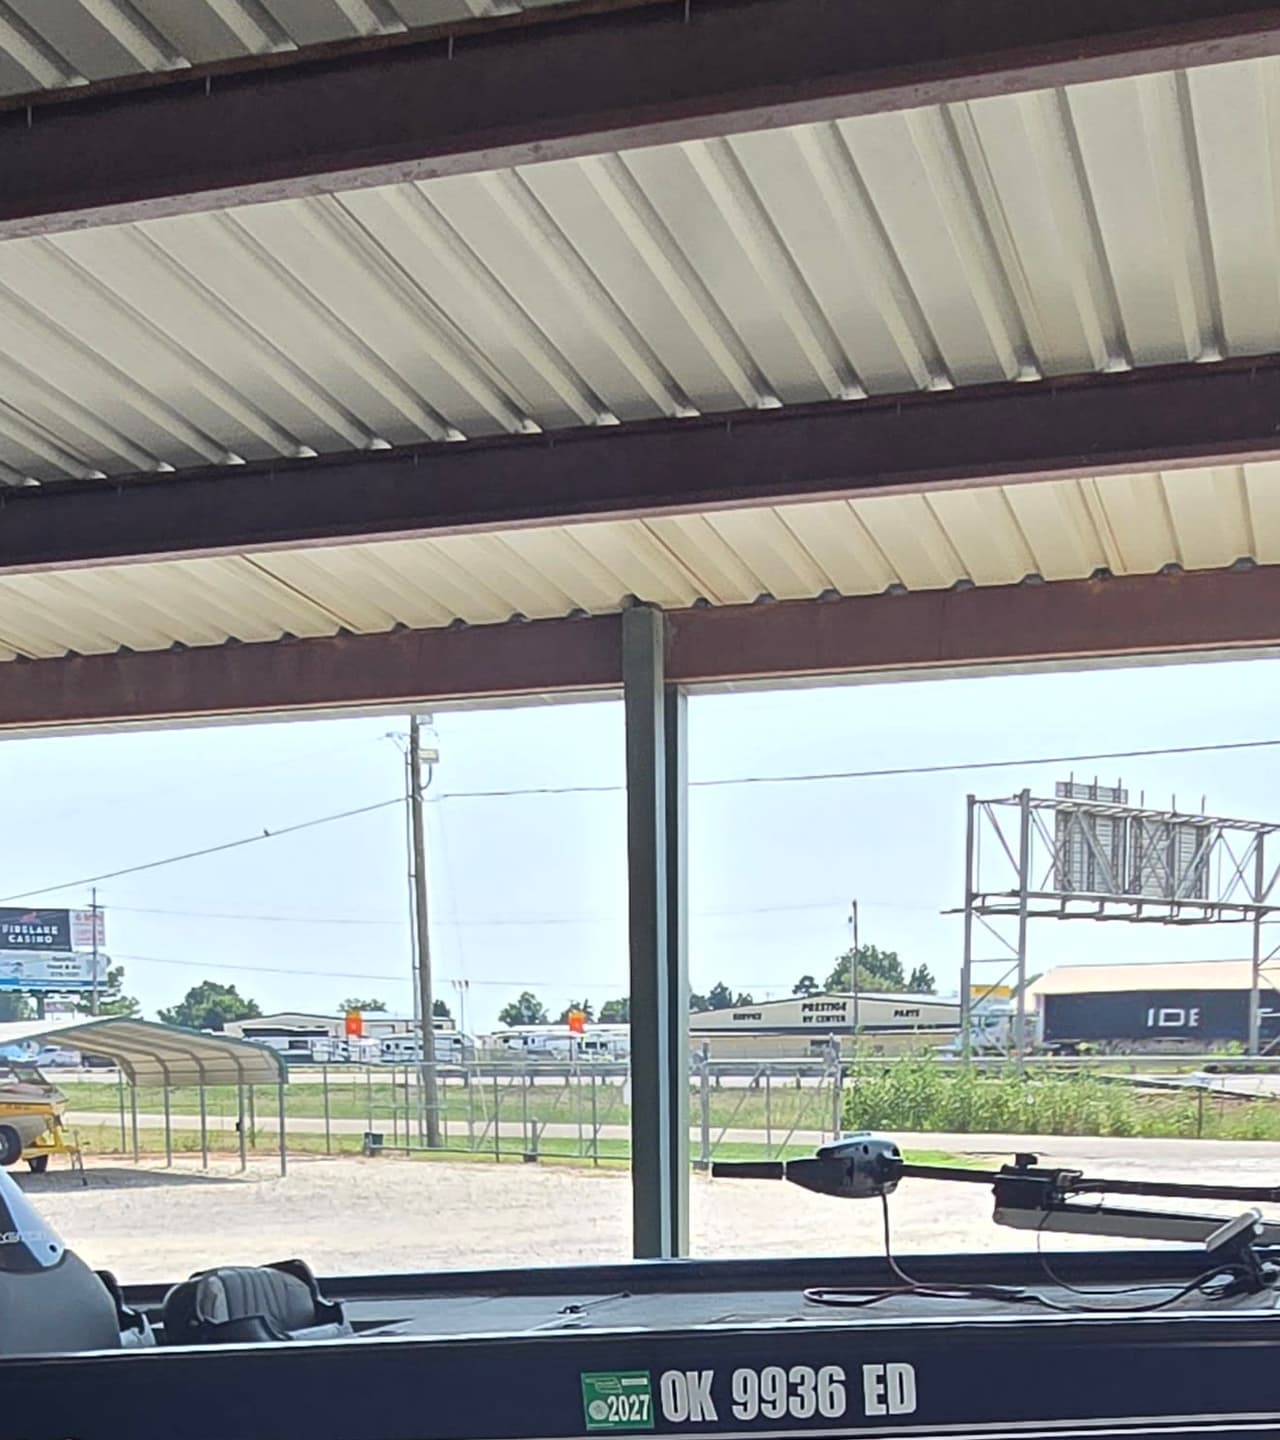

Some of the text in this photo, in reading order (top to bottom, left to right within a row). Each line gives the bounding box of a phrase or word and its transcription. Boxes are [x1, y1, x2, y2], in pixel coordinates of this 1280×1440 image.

[607, 1394, 650, 1422] 2027
[660, 1362, 917, 1423] OK 9936 ED
